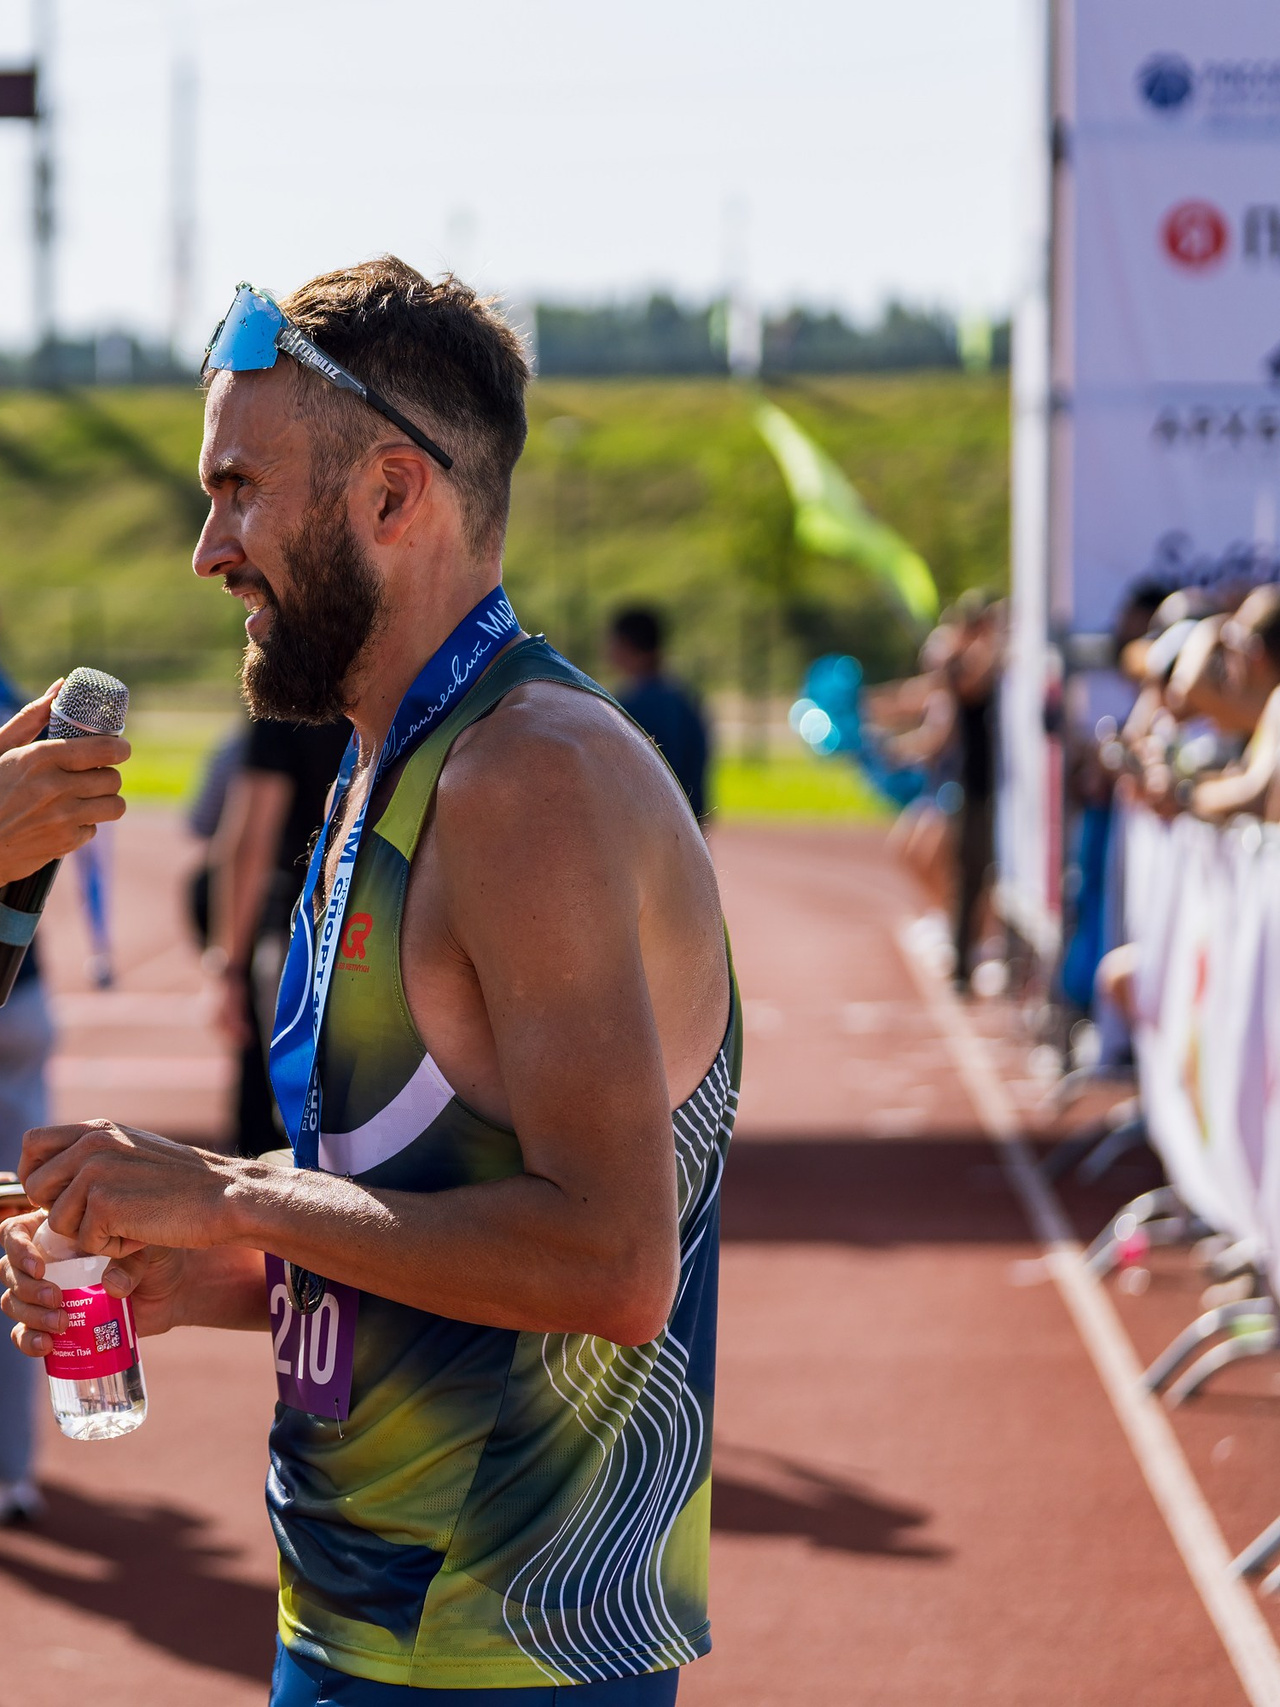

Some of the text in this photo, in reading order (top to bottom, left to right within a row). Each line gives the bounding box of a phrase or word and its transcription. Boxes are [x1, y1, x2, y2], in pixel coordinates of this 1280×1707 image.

[476, 598, 517, 640] МАР
[316, 877, 344, 985] СПОРТ
[66, 1297, 93, 1308] СПОРТУ
